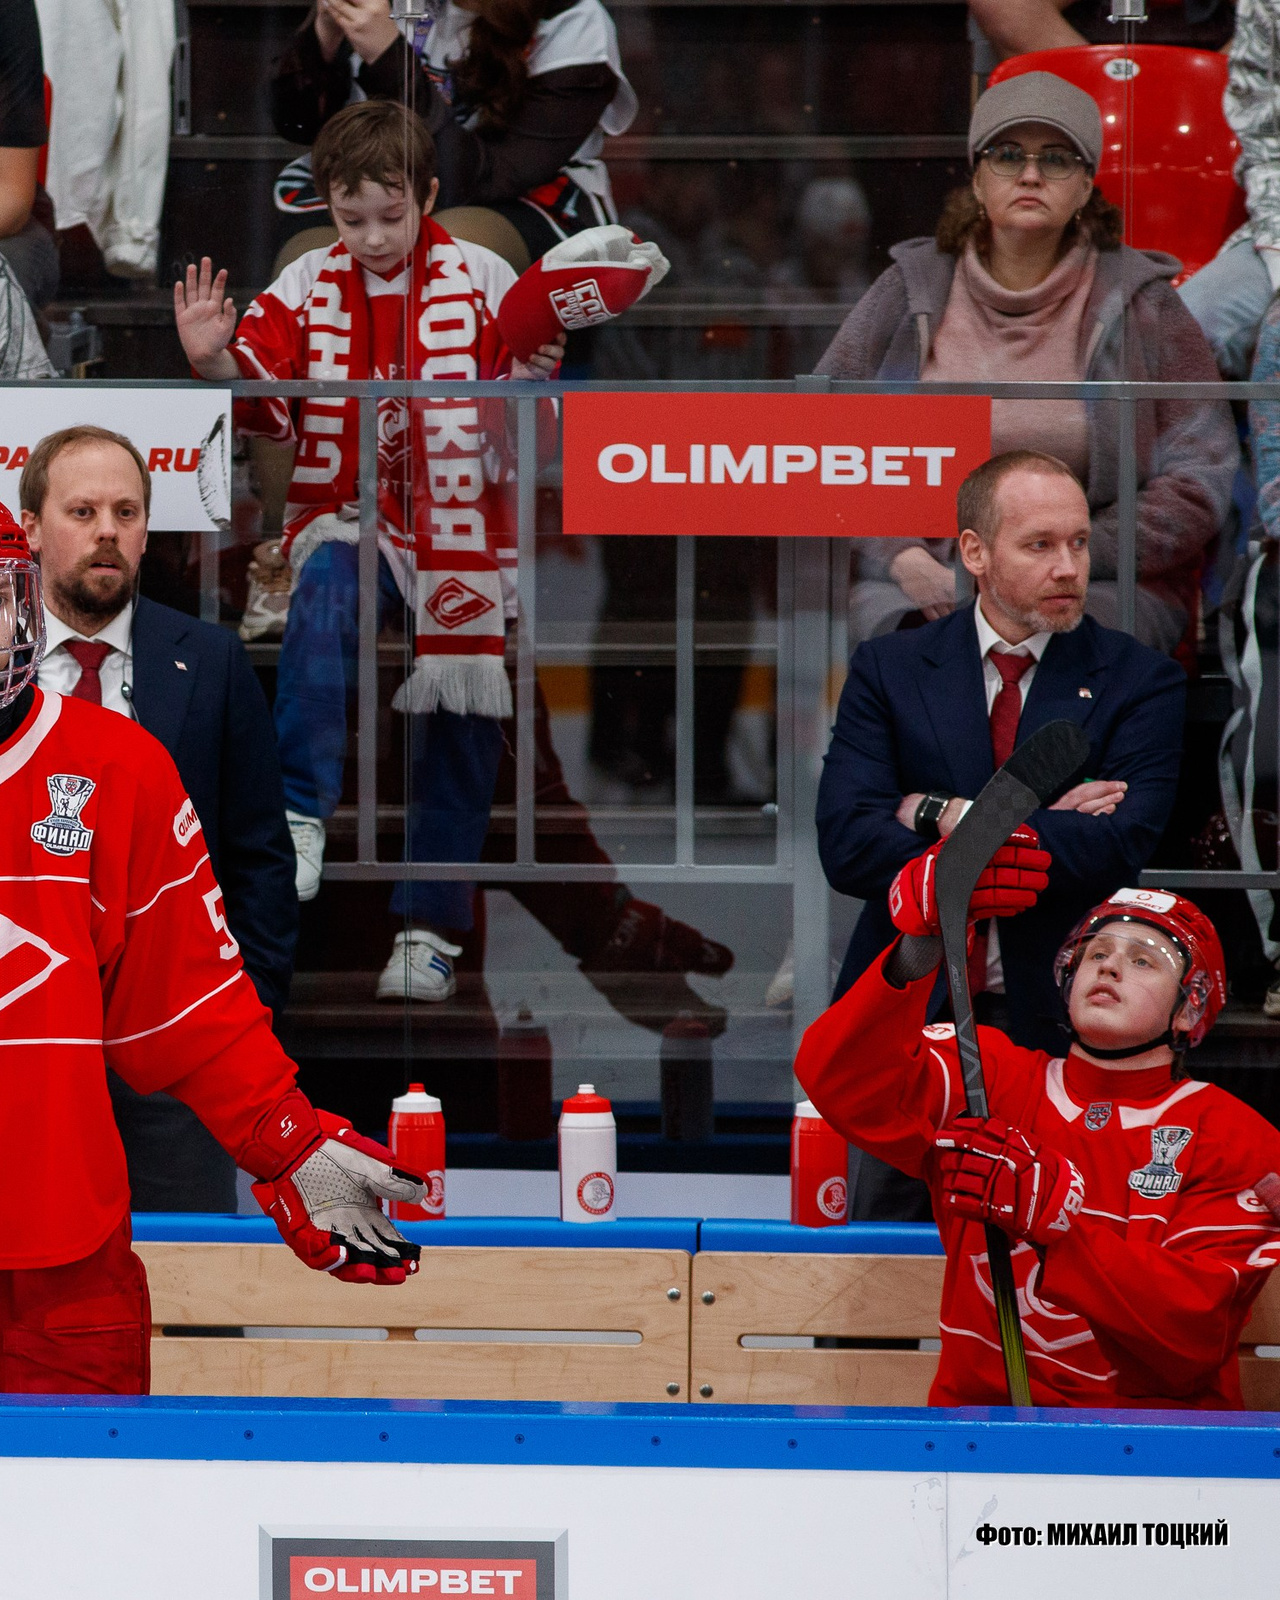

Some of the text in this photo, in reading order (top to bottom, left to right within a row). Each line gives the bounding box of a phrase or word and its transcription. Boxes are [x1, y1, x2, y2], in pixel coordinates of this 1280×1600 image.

[597, 443, 956, 487] OLIMPBET
[33, 824, 91, 848] ФИНАЛ
[1131, 1173, 1181, 1192] ФИНАЛ
[304, 1567, 523, 1595] OLIMPBET
